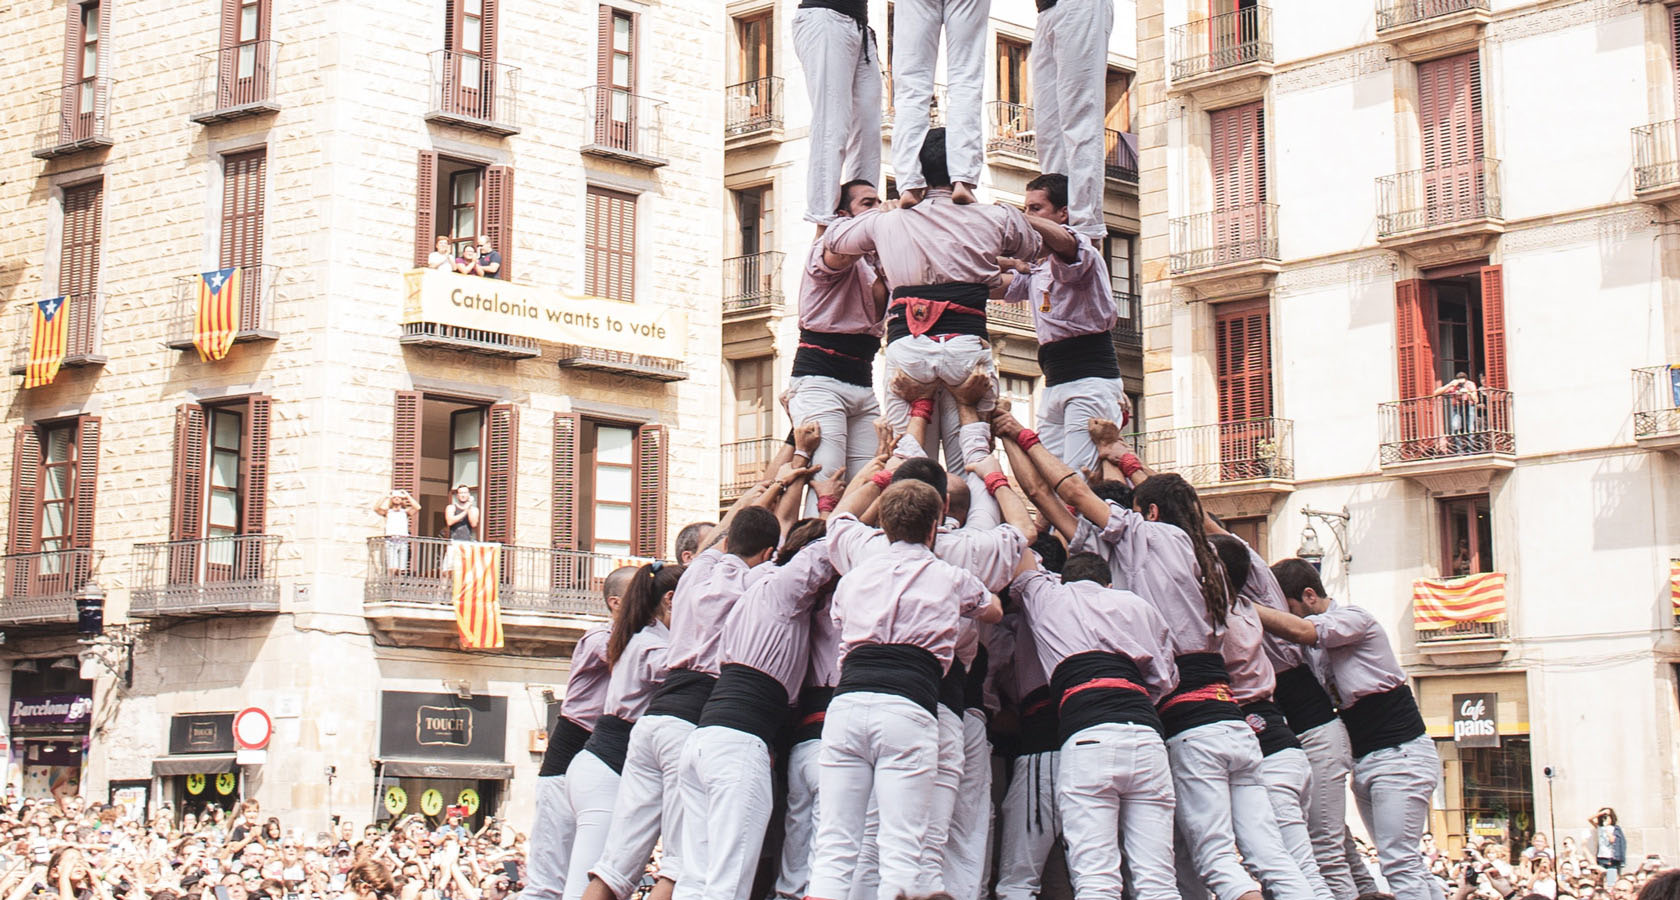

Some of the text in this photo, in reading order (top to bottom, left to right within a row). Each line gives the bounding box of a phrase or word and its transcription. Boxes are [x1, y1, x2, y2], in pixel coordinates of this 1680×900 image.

[451, 288, 666, 339] Catalonia wants to vote
[425, 717, 464, 731] TOUCH
[1454, 719, 1495, 741] pans
